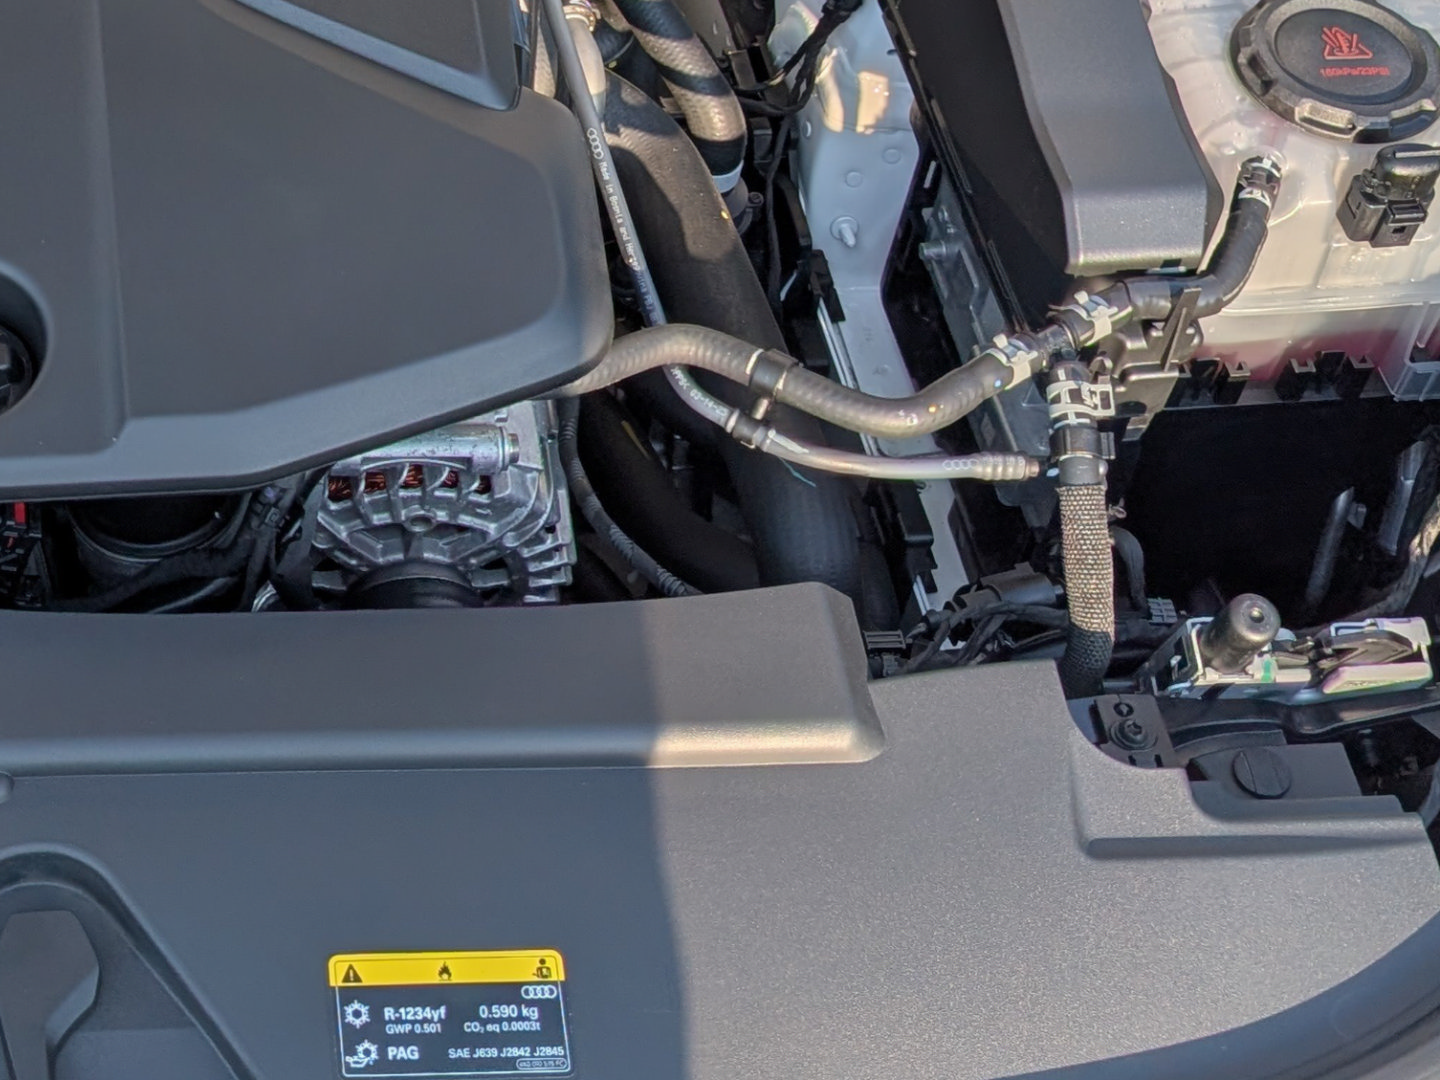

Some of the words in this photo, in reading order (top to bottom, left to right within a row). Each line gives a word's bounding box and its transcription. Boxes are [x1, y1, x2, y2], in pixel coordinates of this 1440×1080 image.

[599, 161, 610, 180] Made
[605, 184, 613, 193] in
[609, 195, 623, 224] Bosnia
[619, 226, 631, 240] and
[383, 1005, 447, 1022] R-1234yf
[479, 1004, 518, 1018] 0.590
[521, 1003, 539, 1020] kg
[385, 1024, 412, 1035] GWP
[414, 1023, 441, 1033] 0.501
[486, 1023, 500, 1033] eq
[501, 1021, 541, 1031] 0.0003t
[387, 1045, 420, 1060] PAG
[448, 1048, 471, 1058] SAE
[472, 1047, 498, 1058] J639
[500, 1047, 531, 1057] J2842
[533, 1046, 565, 1057] J2845
